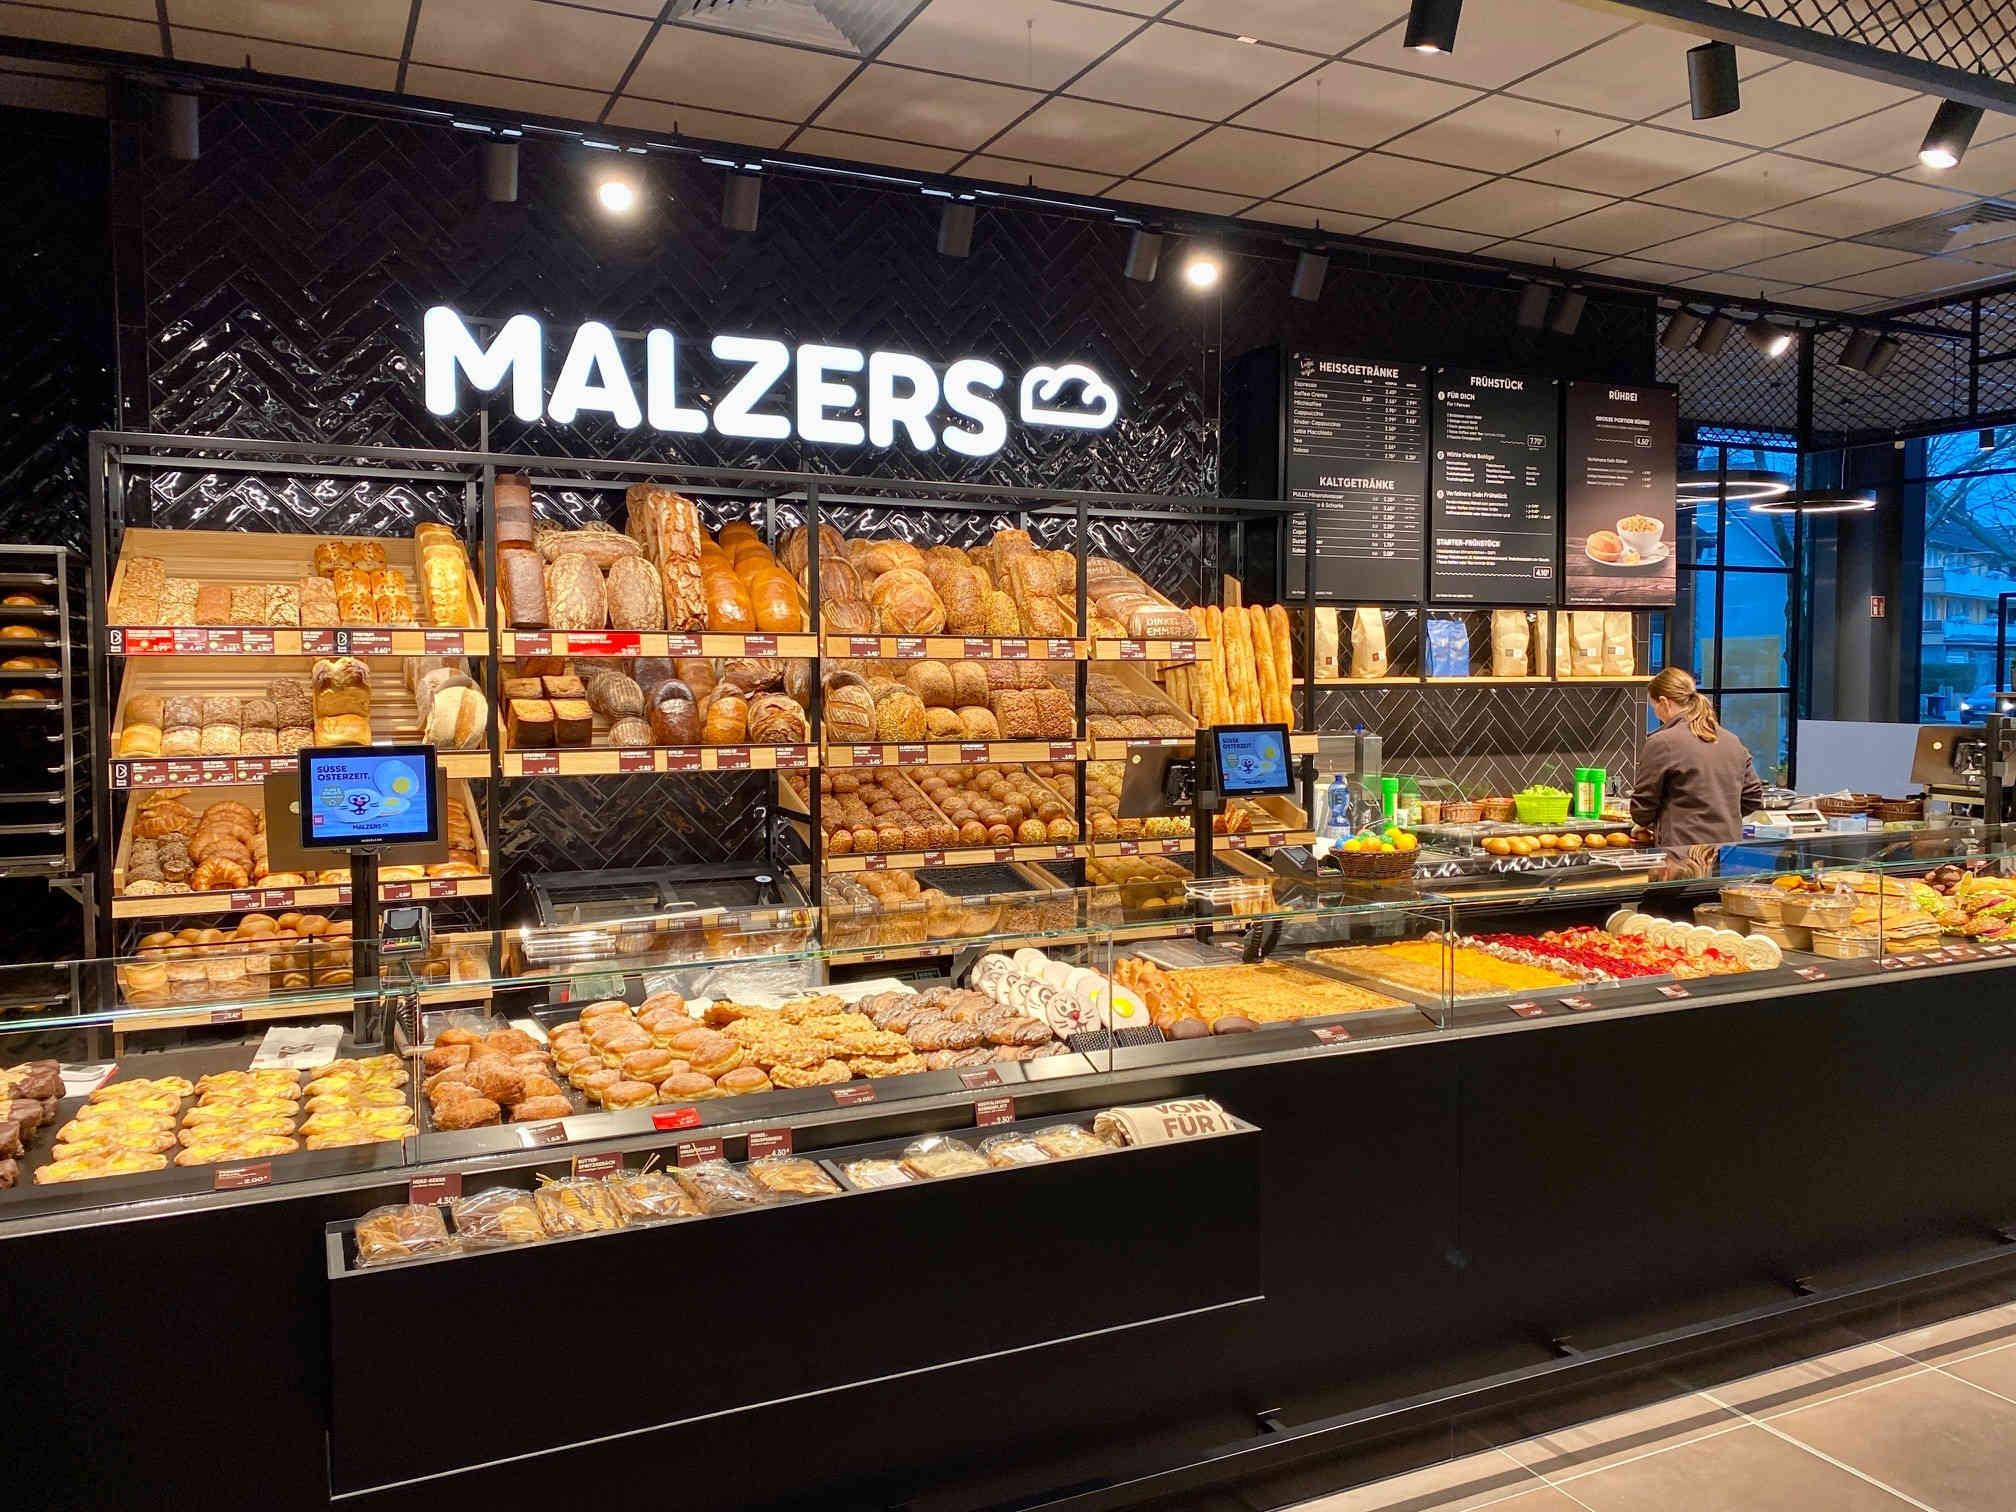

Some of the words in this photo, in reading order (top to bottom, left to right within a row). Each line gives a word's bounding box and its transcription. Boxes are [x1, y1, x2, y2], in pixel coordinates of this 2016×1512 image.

[1319, 361, 1399, 379] HEISSGETRÄNKE
[424, 304, 1007, 456] MALZERS
[1470, 376, 1523, 390] FRÜHSTÜCK
[1447, 391, 1459, 399] FÜR
[1460, 392, 1475, 400] DICH
[1608, 389, 1638, 402] RÜHREI
[1319, 477, 1395, 490] KALTGETRÄNKE
[317, 765, 347, 773] SÜSSE
[317, 772, 371, 781] OSTERZEIT.
[1154, 1100, 1211, 1115] VON
[1162, 1112, 1216, 1138] FÜR
